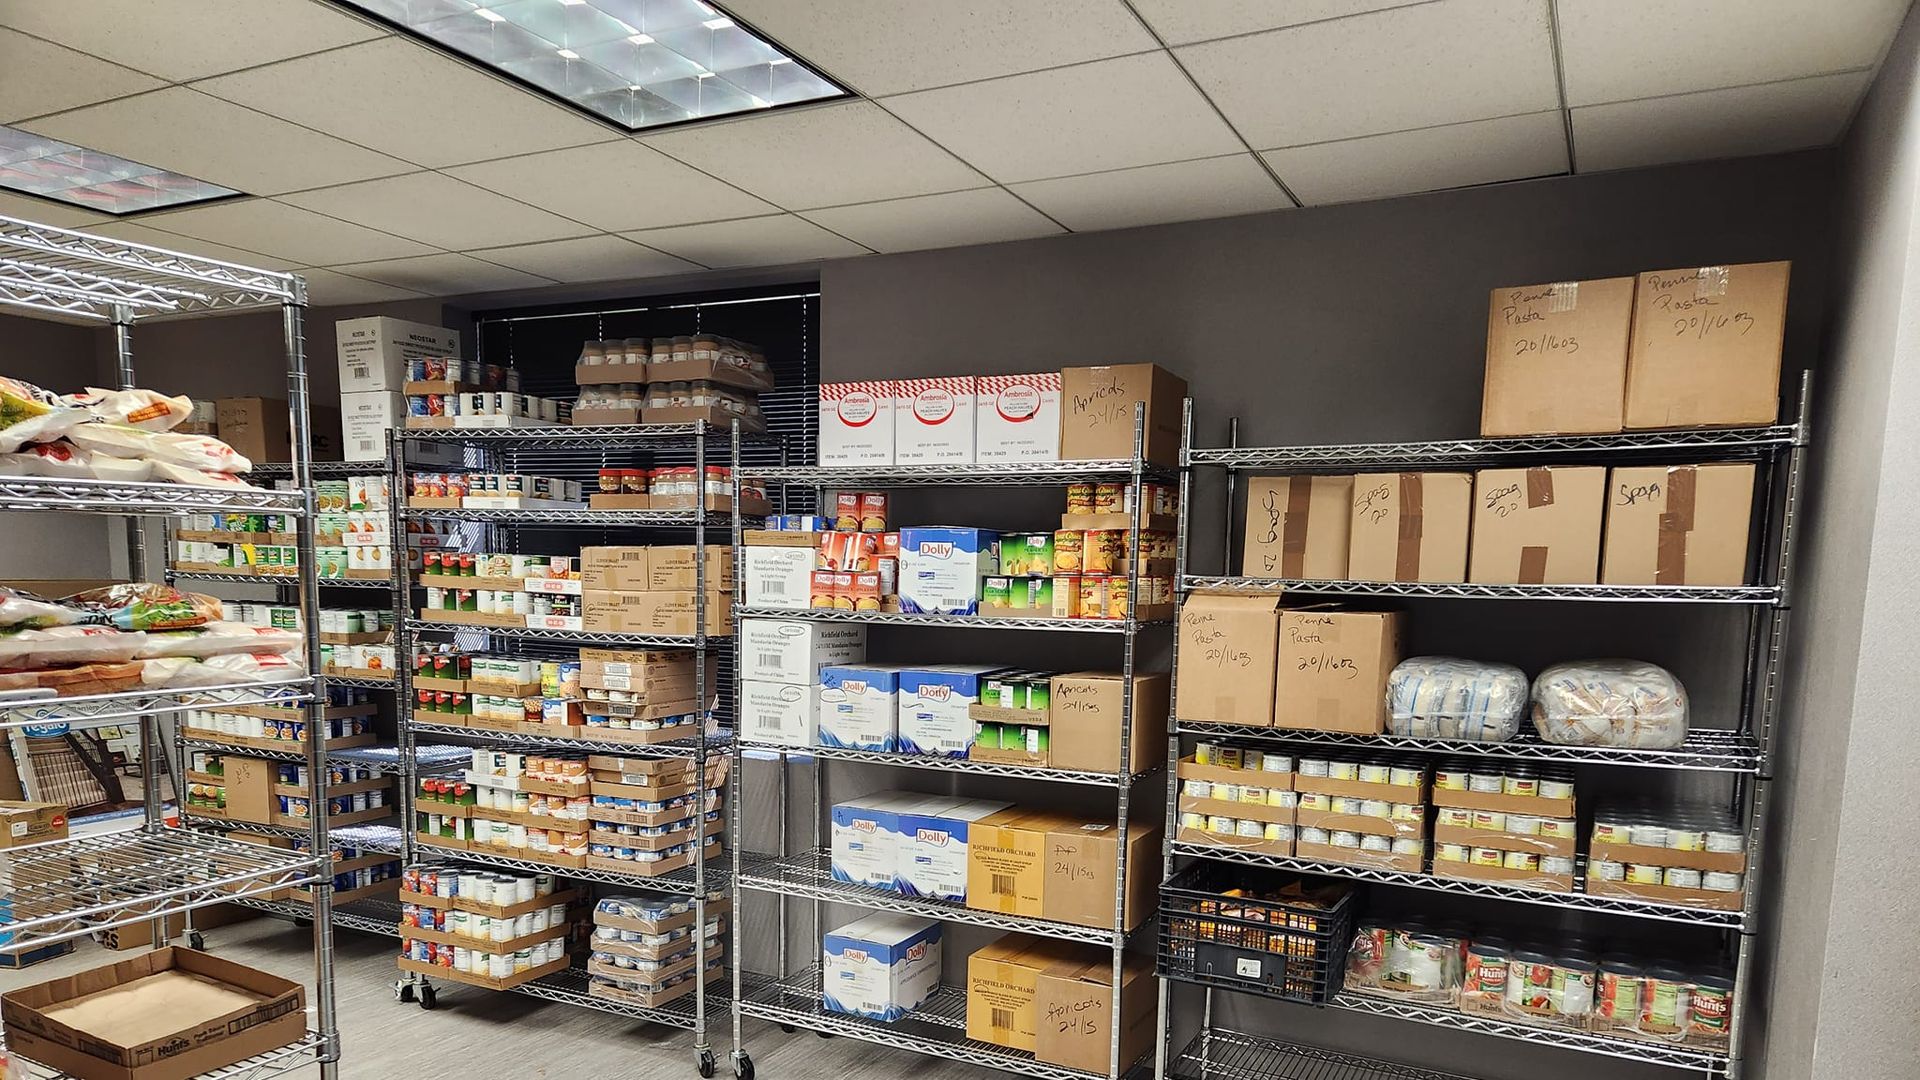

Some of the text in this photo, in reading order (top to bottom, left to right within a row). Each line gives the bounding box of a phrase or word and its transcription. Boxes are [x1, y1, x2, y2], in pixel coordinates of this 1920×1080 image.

[1649, 271, 1706, 292] Penne
[1653, 294, 1718, 312] Pasta
[1503, 306, 1544, 322] Pasta
[1371, 508, 1388, 524] 20
[1496, 502, 1518, 518] 20
[922, 543, 950, 558] Dolly
[816, 575, 833, 583] Dolly
[1184, 612, 1216, 626] Penne
[1296, 615, 1335, 626] Penne
[1192, 627, 1226, 646] Pasta
[1288, 626, 1324, 644] Pasta
[843, 682, 865, 693] Dolly
[1056, 683, 1098, 698] Apricots
[853, 821, 875, 832] Dolly
[920, 831, 946, 845] Dolly
[972, 845, 1036, 858] RICHFIELD ORCHARD
[845, 950, 865, 962] Dolly
[908, 943, 926, 960] Dolly
[972, 978, 1035, 994] RICHFIELD ORCHARD
[1045, 995, 1102, 1022] Apricots
[1060, 1015, 1096, 1035] 24/15
[158, 1038, 190, 1056] Hunt's
